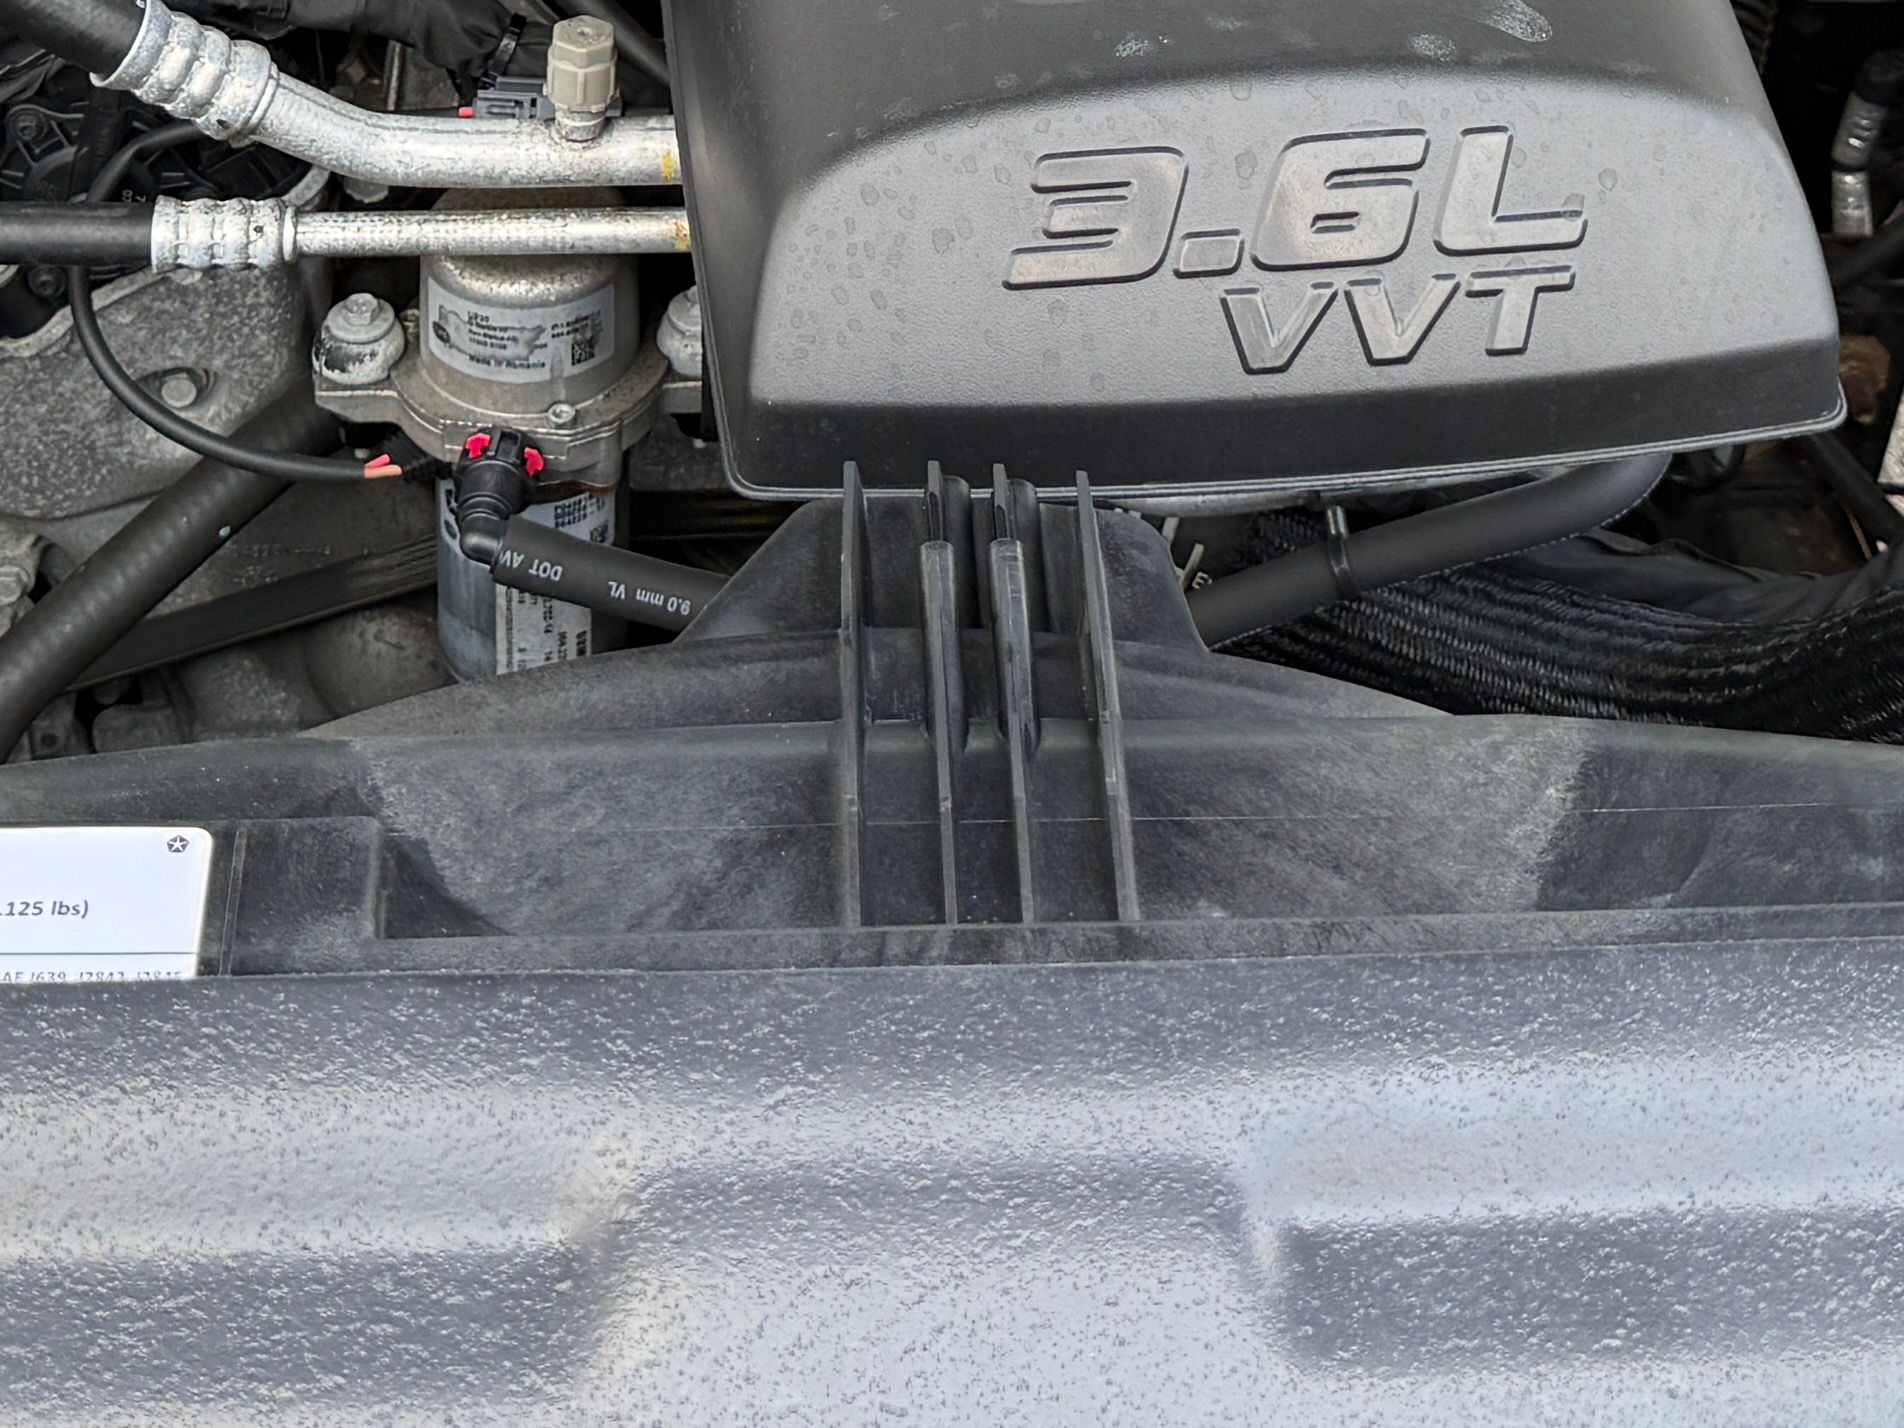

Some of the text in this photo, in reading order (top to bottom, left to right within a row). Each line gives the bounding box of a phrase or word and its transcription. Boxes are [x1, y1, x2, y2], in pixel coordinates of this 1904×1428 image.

[1002, 122, 1588, 291] 3.6L
[1219, 266, 1575, 376] VVT
[498, 549, 691, 615] 9.0 mm VL DOT AV
[49, 898, 91, 921] lbs)
